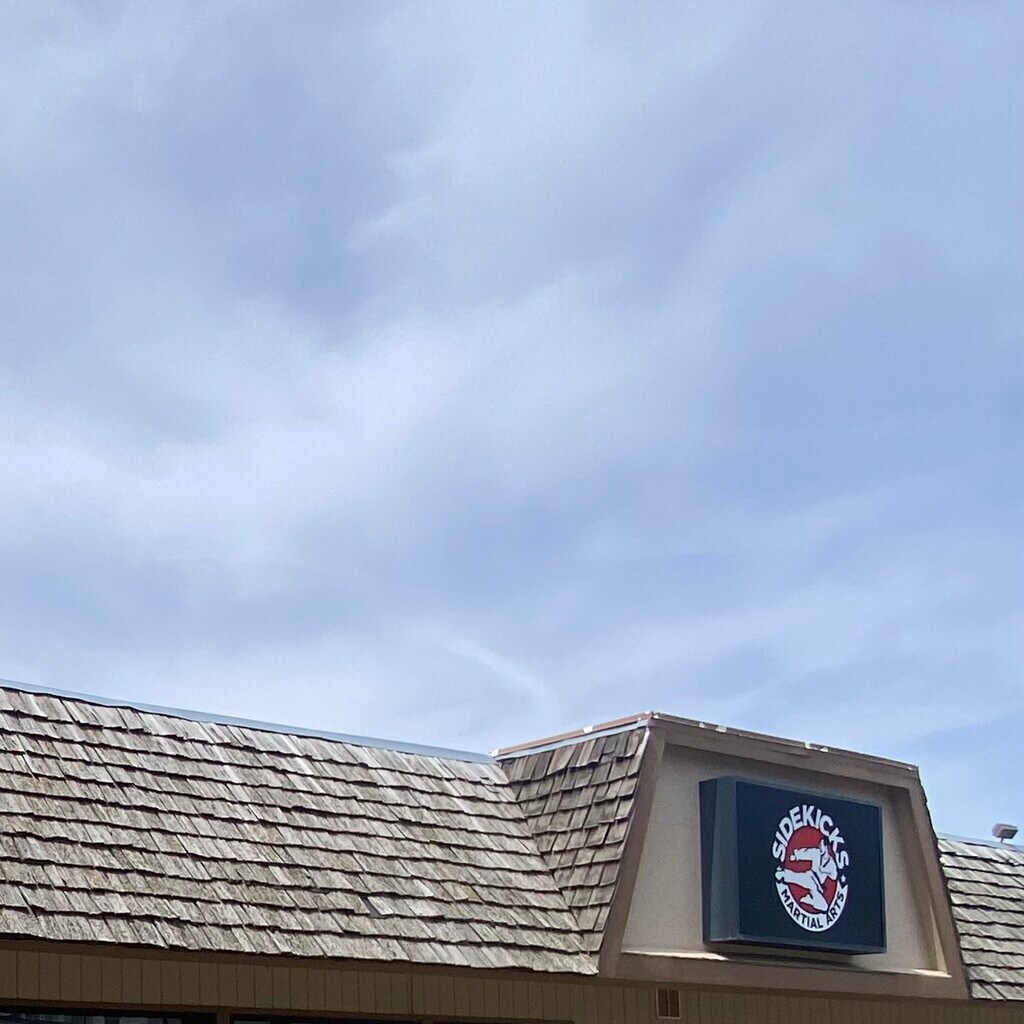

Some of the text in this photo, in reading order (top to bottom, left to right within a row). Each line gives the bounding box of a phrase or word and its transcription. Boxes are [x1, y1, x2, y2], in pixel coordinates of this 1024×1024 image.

[772, 804, 849, 869] SIDEKICKS
[781, 888, 845, 929] MARTIAL ARTS
